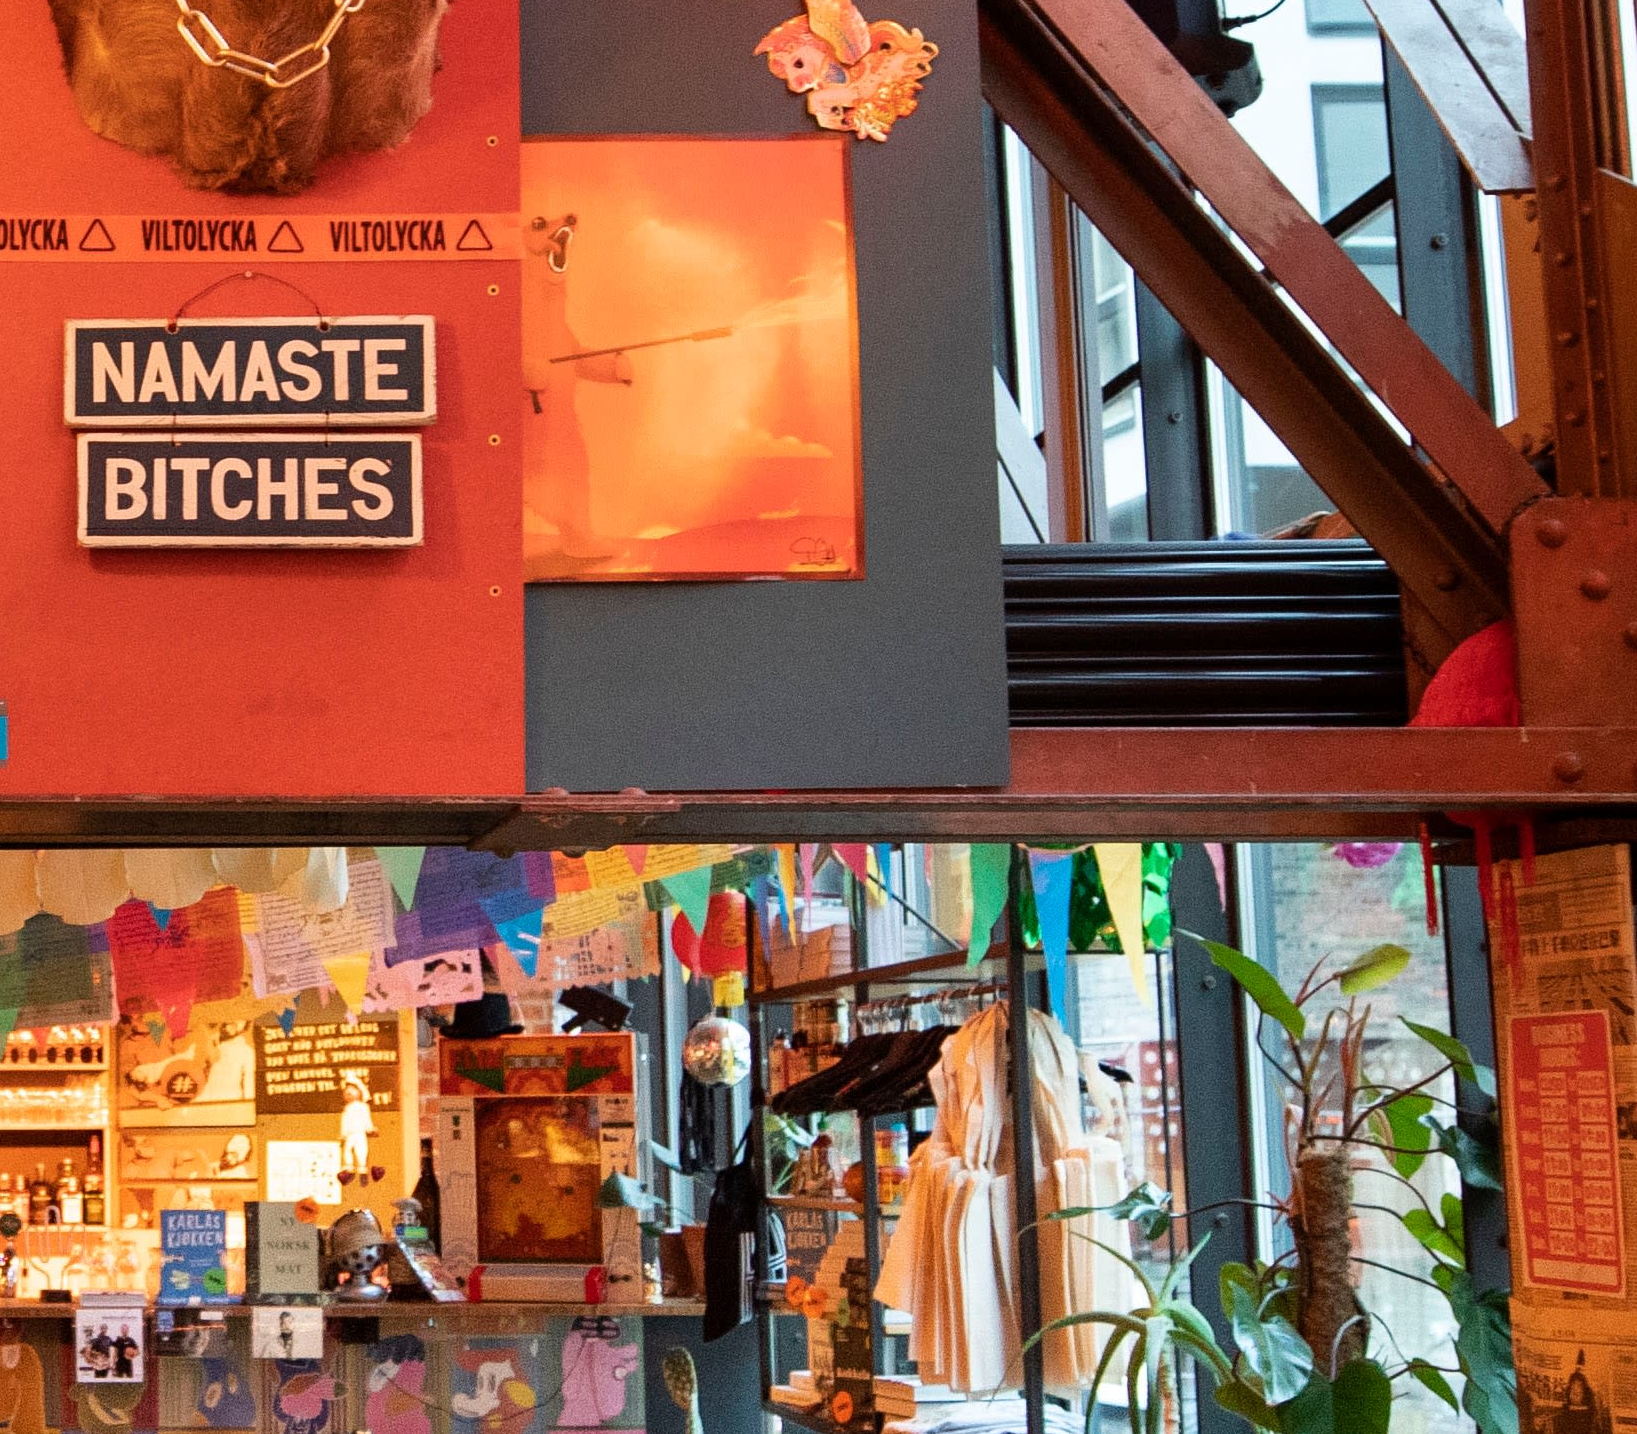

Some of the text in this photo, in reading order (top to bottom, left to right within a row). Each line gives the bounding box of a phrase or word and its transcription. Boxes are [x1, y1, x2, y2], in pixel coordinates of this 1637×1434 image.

[141, 219, 258, 253] VILTOLYCKA
[330, 219, 447, 253] VILTOLYCKA
[91, 338, 409, 403] NAMASTE
[104, 456, 396, 522] BITCHES
[167, 1231, 224, 1247] KJØKKEN
[168, 1215, 221, 1232] KARLAS
